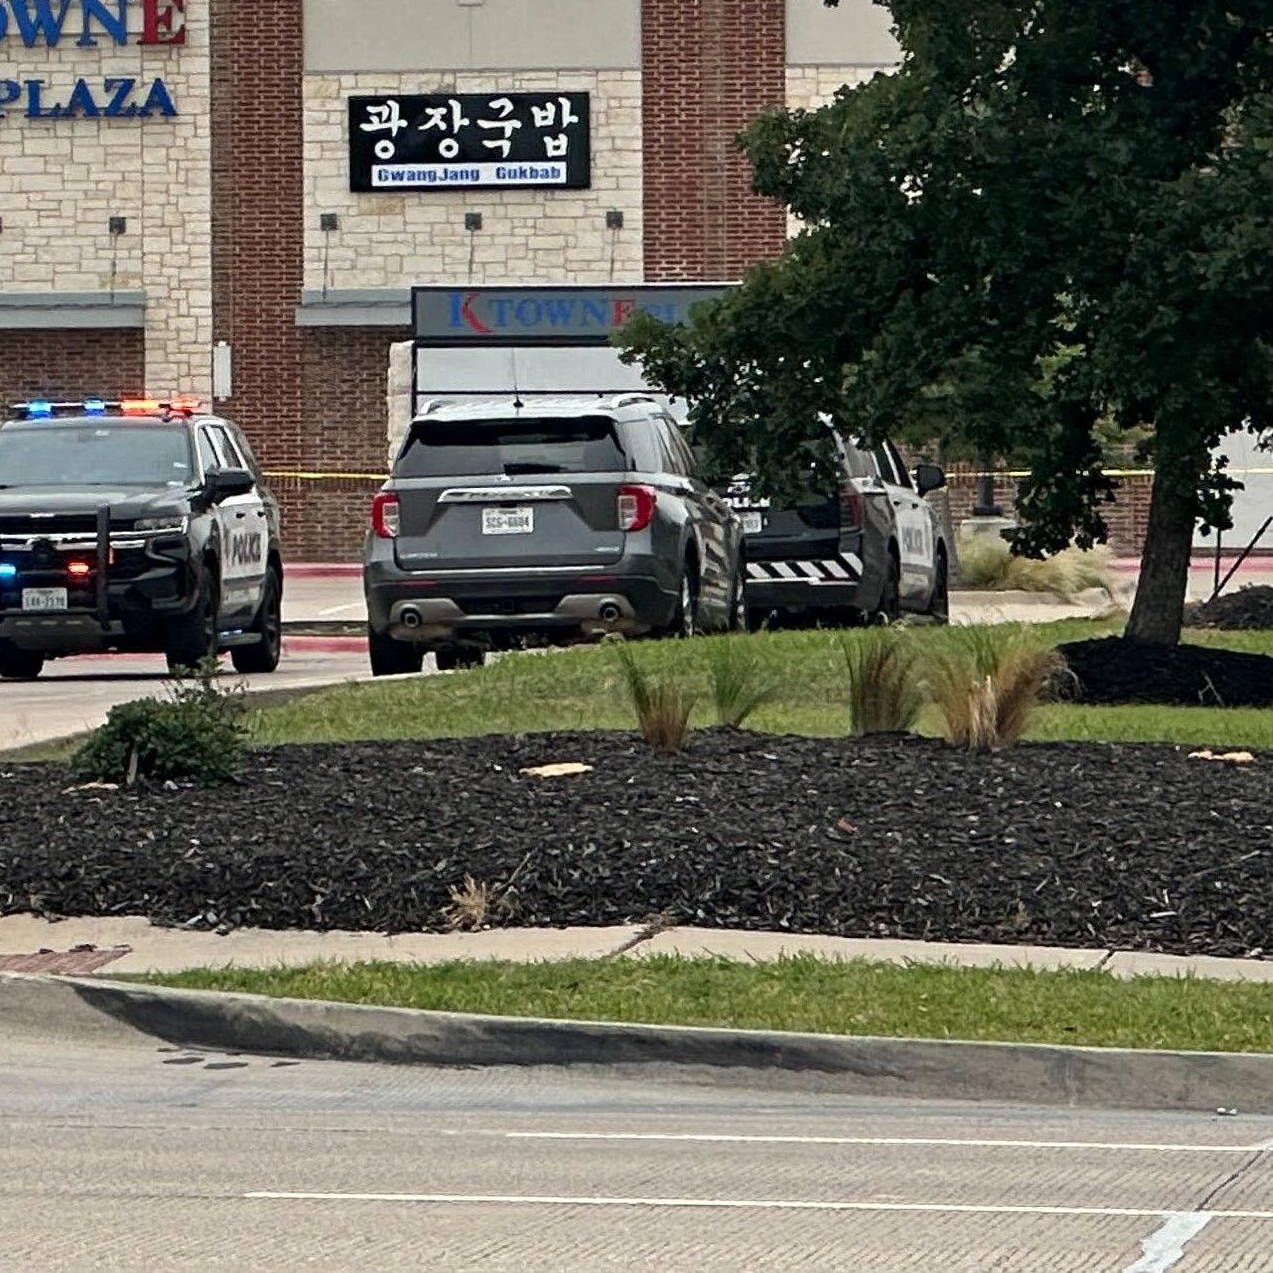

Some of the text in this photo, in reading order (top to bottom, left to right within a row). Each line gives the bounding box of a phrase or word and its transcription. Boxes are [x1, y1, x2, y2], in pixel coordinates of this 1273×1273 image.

[359, 97, 579, 159] 광장국밥
[496, 165, 561, 180] Gukbab
[489, 297, 636, 327] TOWNE
